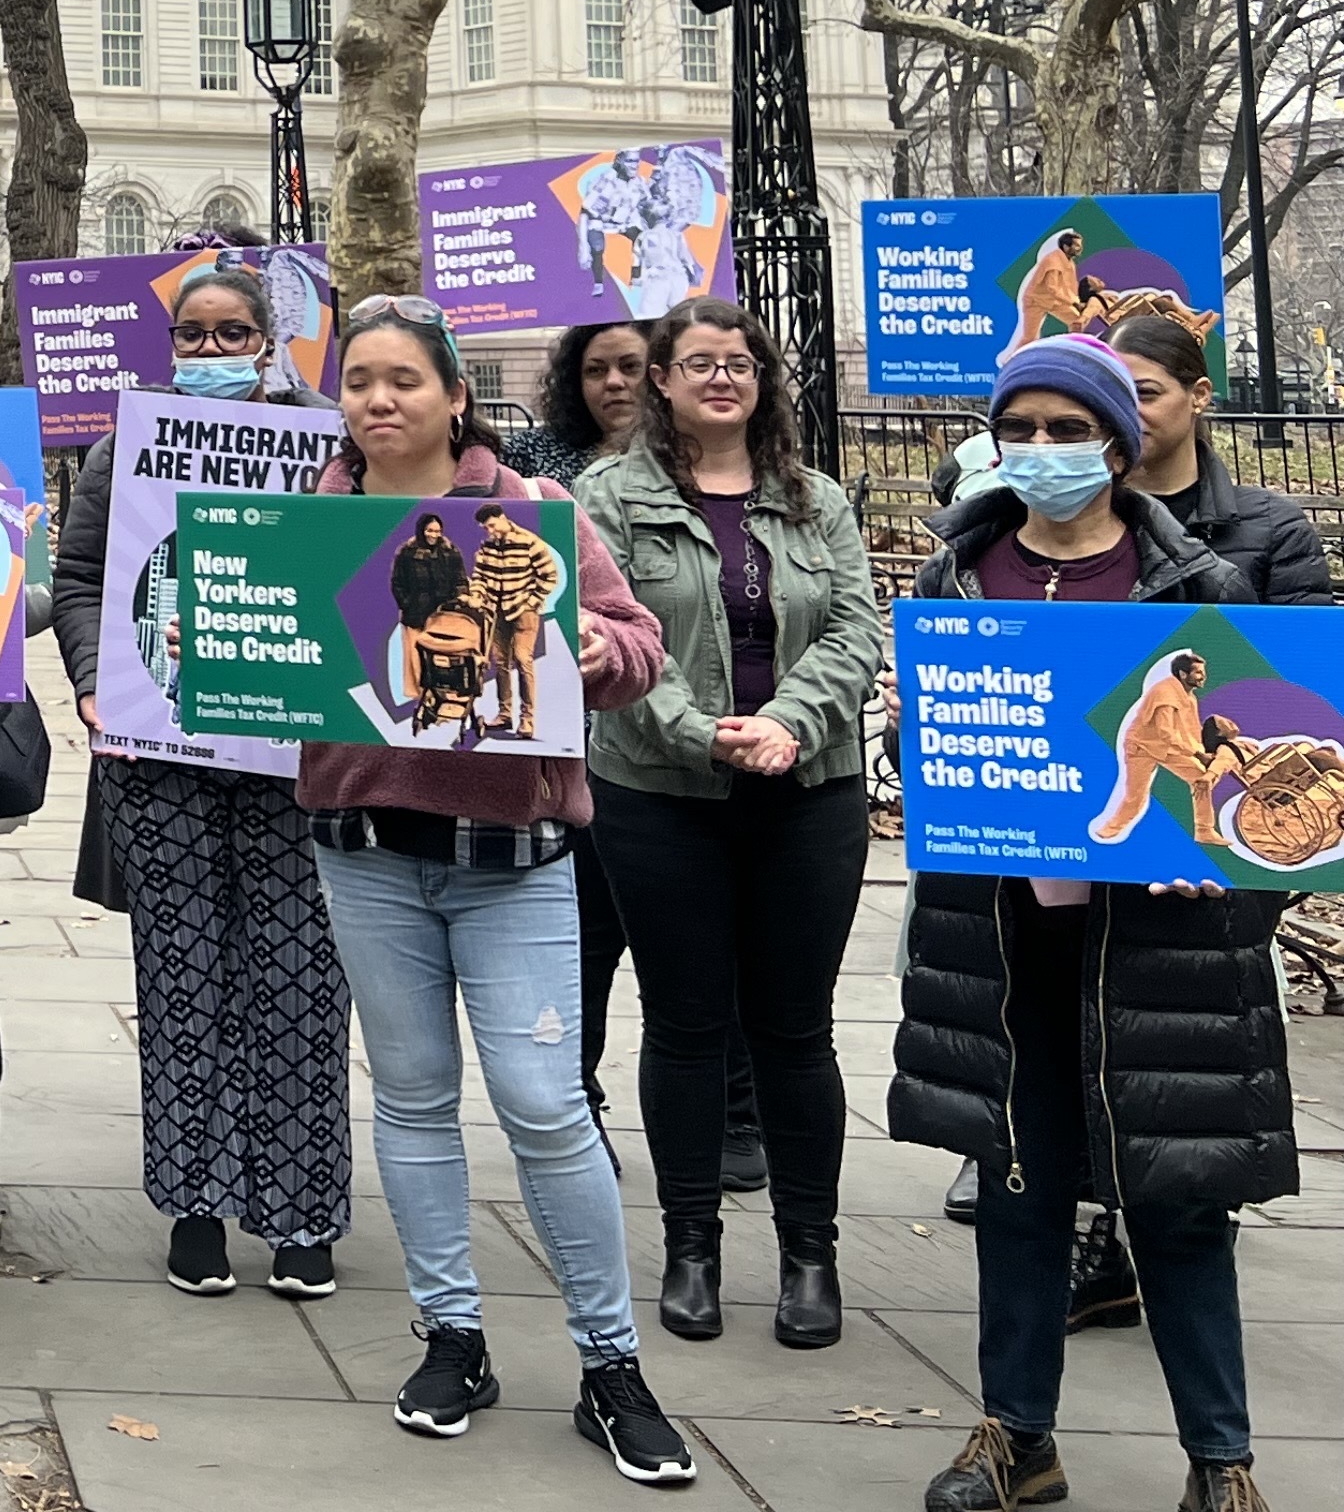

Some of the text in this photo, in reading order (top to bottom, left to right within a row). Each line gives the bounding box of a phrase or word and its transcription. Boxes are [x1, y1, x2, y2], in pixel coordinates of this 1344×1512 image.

[432, 201, 537, 227] Immigrant
[891, 212, 916, 225] NYIC
[433, 229, 512, 251] Families
[434, 250, 515, 270] Deserve
[876, 246, 974, 272] Working
[435, 264, 535, 290] the Credit
[878, 269, 968, 289] Families
[878, 292, 971, 312] Deserve
[31, 302, 139, 327] Immigrant
[879, 314, 993, 335] the Credit
[34, 329, 115, 351] Families
[36, 354, 119, 373] Deserve
[38, 370, 140, 394] the Credit
[154, 417, 338, 463] IMMIGRANT
[133, 448, 192, 481] ARE
[201, 455, 271, 490] NEW
[208, 508, 237, 524] NYIC
[193, 550, 247, 576] New
[194, 578, 297, 606] Yorkers
[194, 606, 298, 634] Deserve
[934, 617, 970, 635] NYIC
[194, 634, 323, 665] the Credit
[916, 664, 1054, 703] Working
[196, 691, 284, 709] Pass The Working
[918, 696, 1046, 727] Families
[196, 706, 236, 720] Families
[238, 709, 254, 720] Tax
[256, 710, 289, 724] Credit
[104, 734, 128, 746] TEXT
[165, 742, 179, 754] TO
[920, 727, 1050, 759] Deserve
[921, 758, 1083, 793] the Credit
[925, 824, 1036, 844] Pass The Working
[926, 841, 1087, 862] Families Tax Credit (WFTC)
